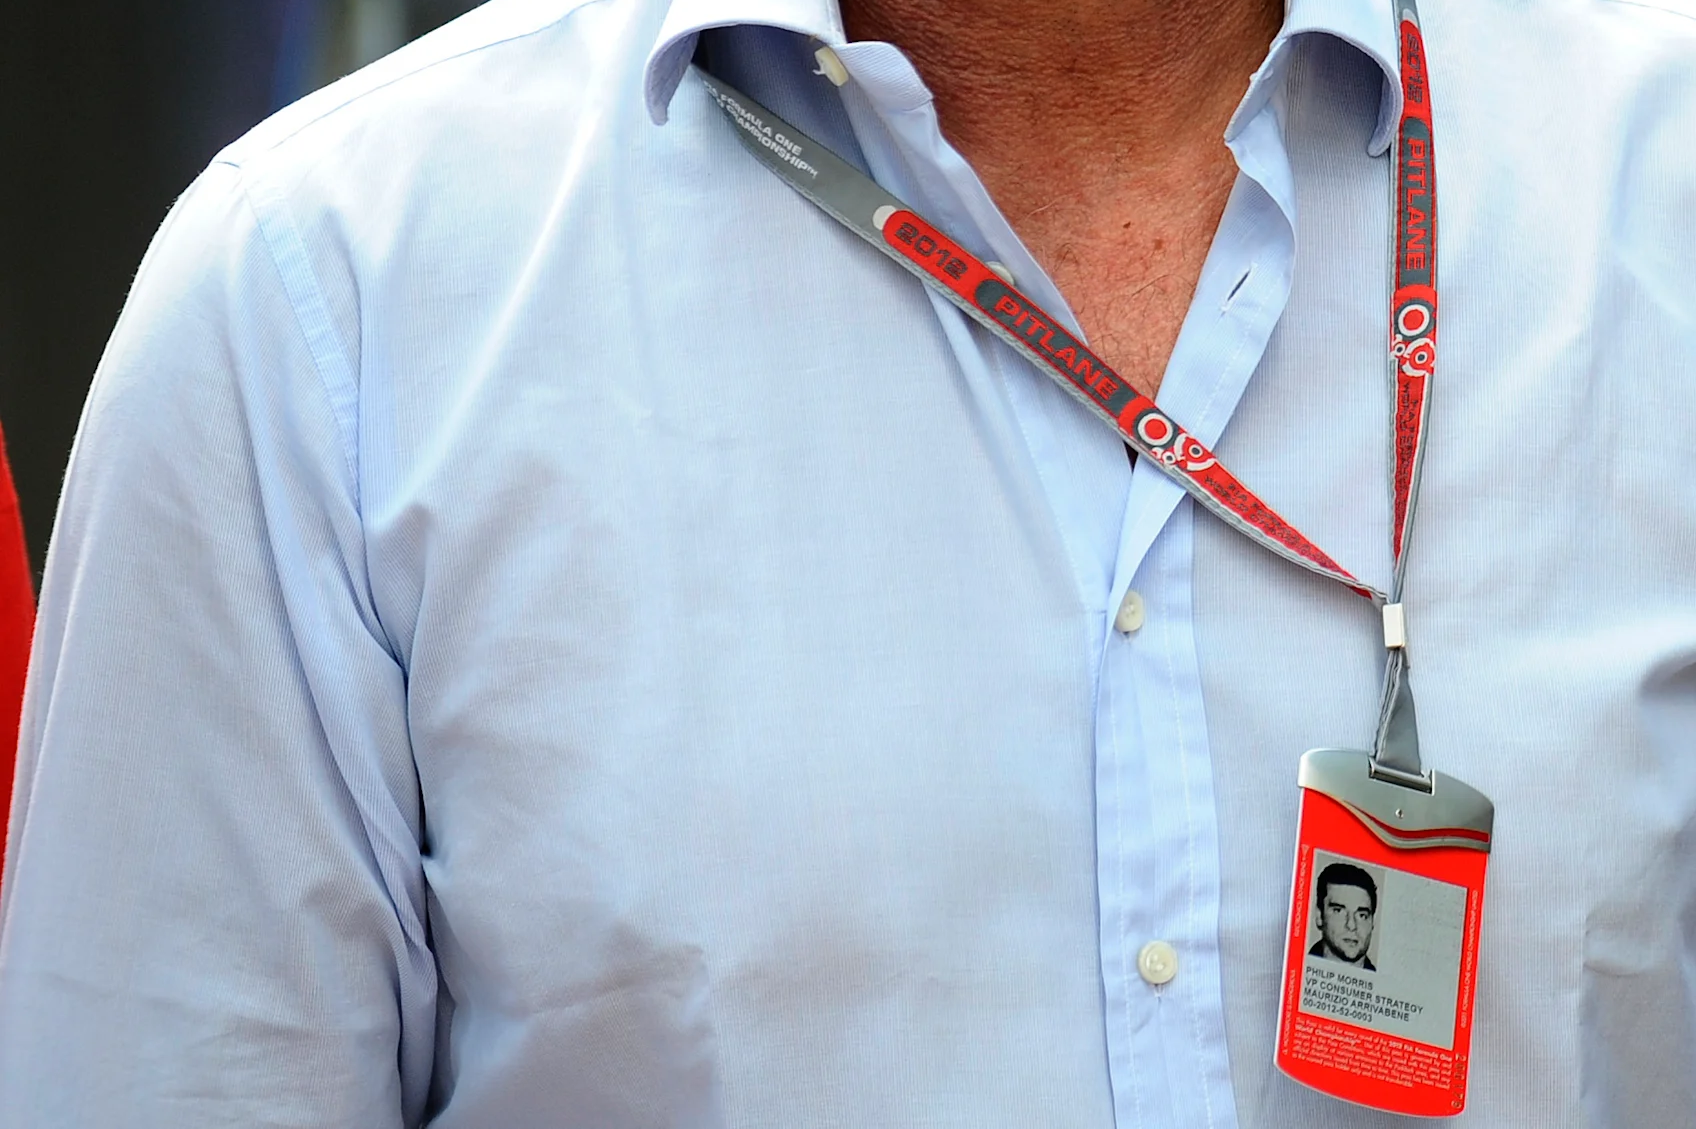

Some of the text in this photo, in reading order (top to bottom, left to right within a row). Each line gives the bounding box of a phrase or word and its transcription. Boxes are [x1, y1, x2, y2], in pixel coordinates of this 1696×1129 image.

[1406, 33, 1424, 105] 2012
[720, 93, 773, 138] FORMULA
[775, 133, 803, 157] ONE
[1406, 136, 1427, 271] PITLANE
[893, 221, 969, 281] 2012
[993, 294, 1121, 401] PITLANE
[1303, 987, 1410, 1022] MAURIZIO ARRIVABENE
[1305, 965, 1374, 991] PHILIP MORRIS
[1305, 977, 1425, 1015] VP CONSUMER STRATEGY
[1302, 997, 1373, 1023] 00-2012-52-0003
